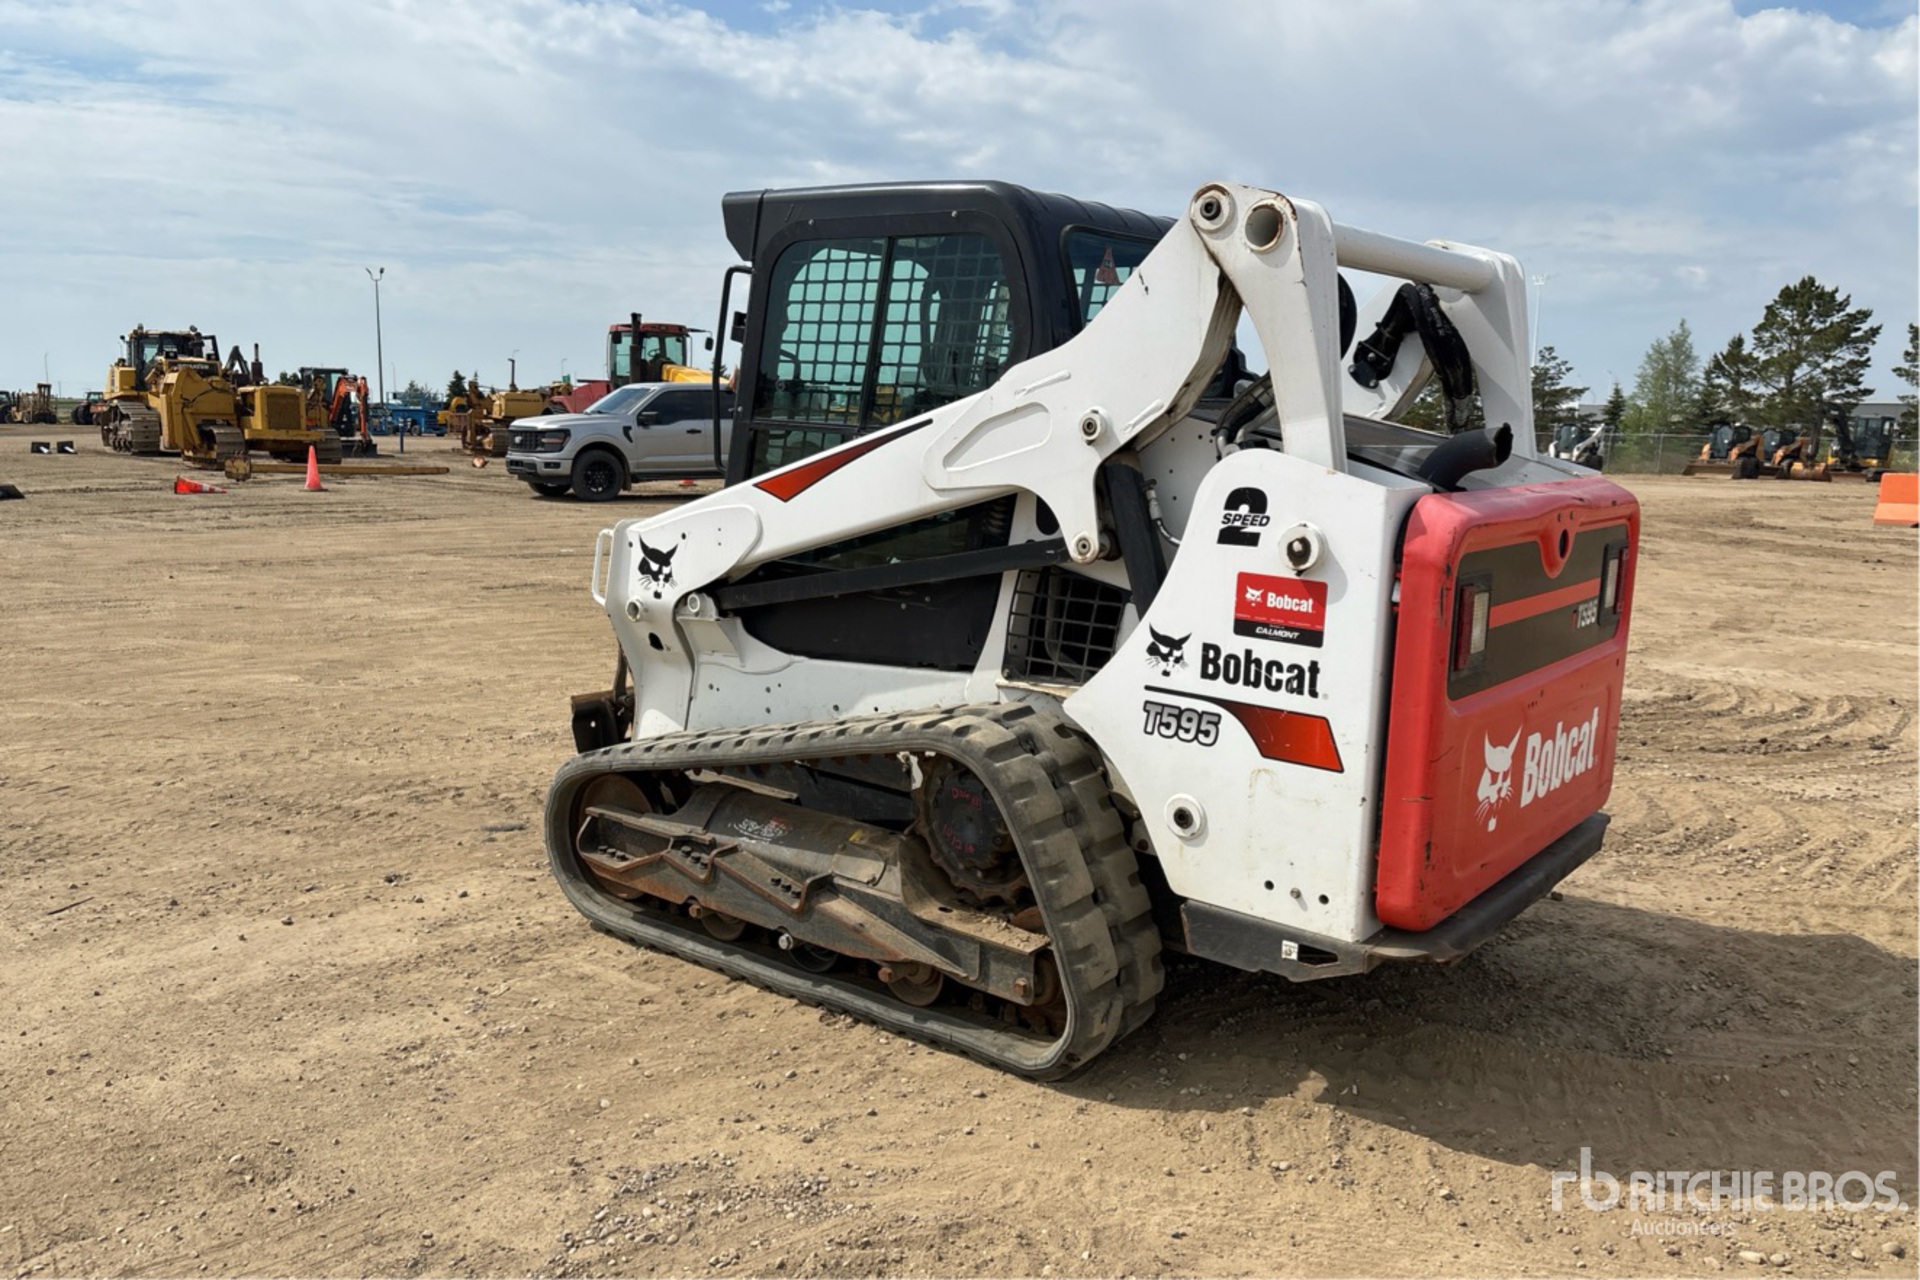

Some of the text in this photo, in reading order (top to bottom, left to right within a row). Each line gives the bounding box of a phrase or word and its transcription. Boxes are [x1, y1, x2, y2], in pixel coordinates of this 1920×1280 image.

[1216, 487, 1268, 547] 2
[1221, 512, 1271, 527] SPEED
[1266, 591, 1314, 613] Bobcat
[1576, 598, 1598, 629] T595
[1255, 626, 1300, 639] CALMONT
[1200, 642, 1320, 699] Bobcat
[1143, 700, 1221, 746] T595
[1520, 707, 1599, 808] Bobcat
